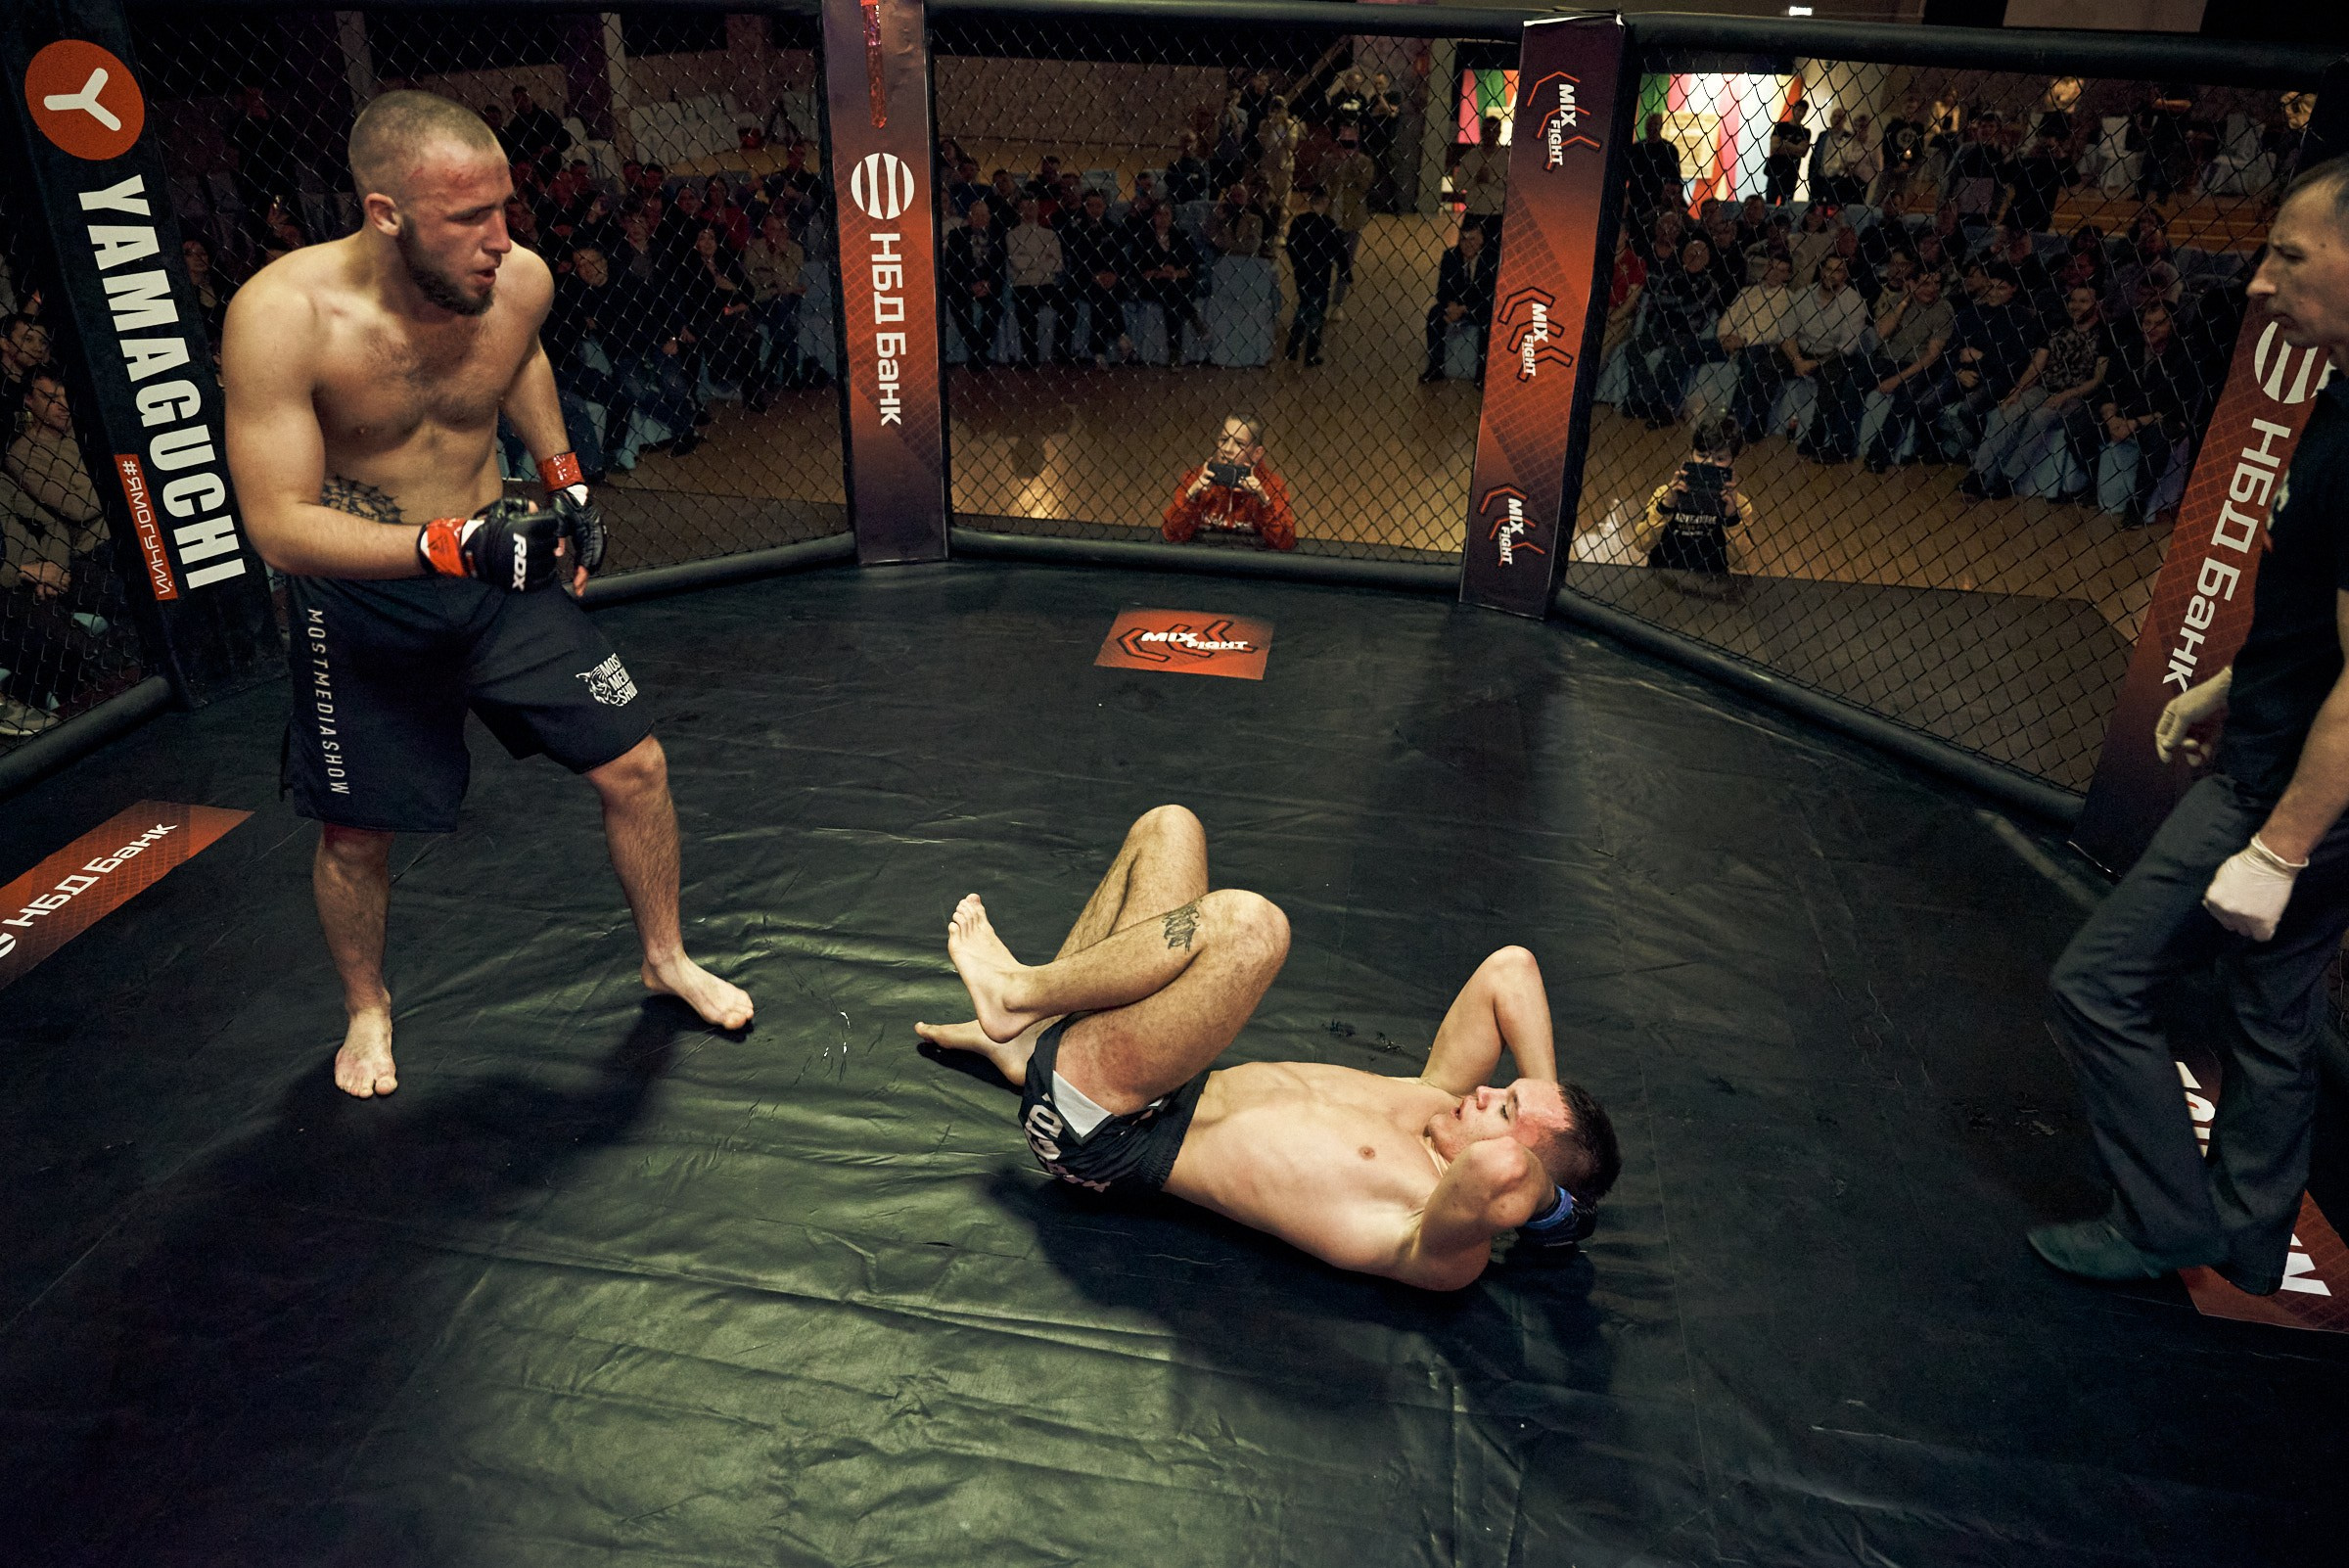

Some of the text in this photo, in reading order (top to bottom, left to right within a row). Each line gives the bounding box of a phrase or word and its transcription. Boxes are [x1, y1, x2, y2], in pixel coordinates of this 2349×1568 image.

[1558, 83, 1577, 127] MIX
[1549, 119, 1563, 165] FIGHT
[870, 233, 906, 426] НБД Банк
[1532, 302, 1548, 343] MIX
[1524, 334, 1536, 376] FIGHT
[78, 174, 246, 589] YAMAGUCHI
[122, 460, 172, 595] #ЯМОГУЧИЙ
[1508, 498, 1524, 534] MIX
[512, 533, 527, 591] RDX
[1500, 526, 1513, 564] FIGHT
[2162, 418, 2291, 692] НБД Банк
[1141, 631, 1198, 643] MIX
[1185, 641, 1248, 650] FIGHT
[598, 653, 622, 677] MOS
[2, 823, 178, 927] НБД Банк
